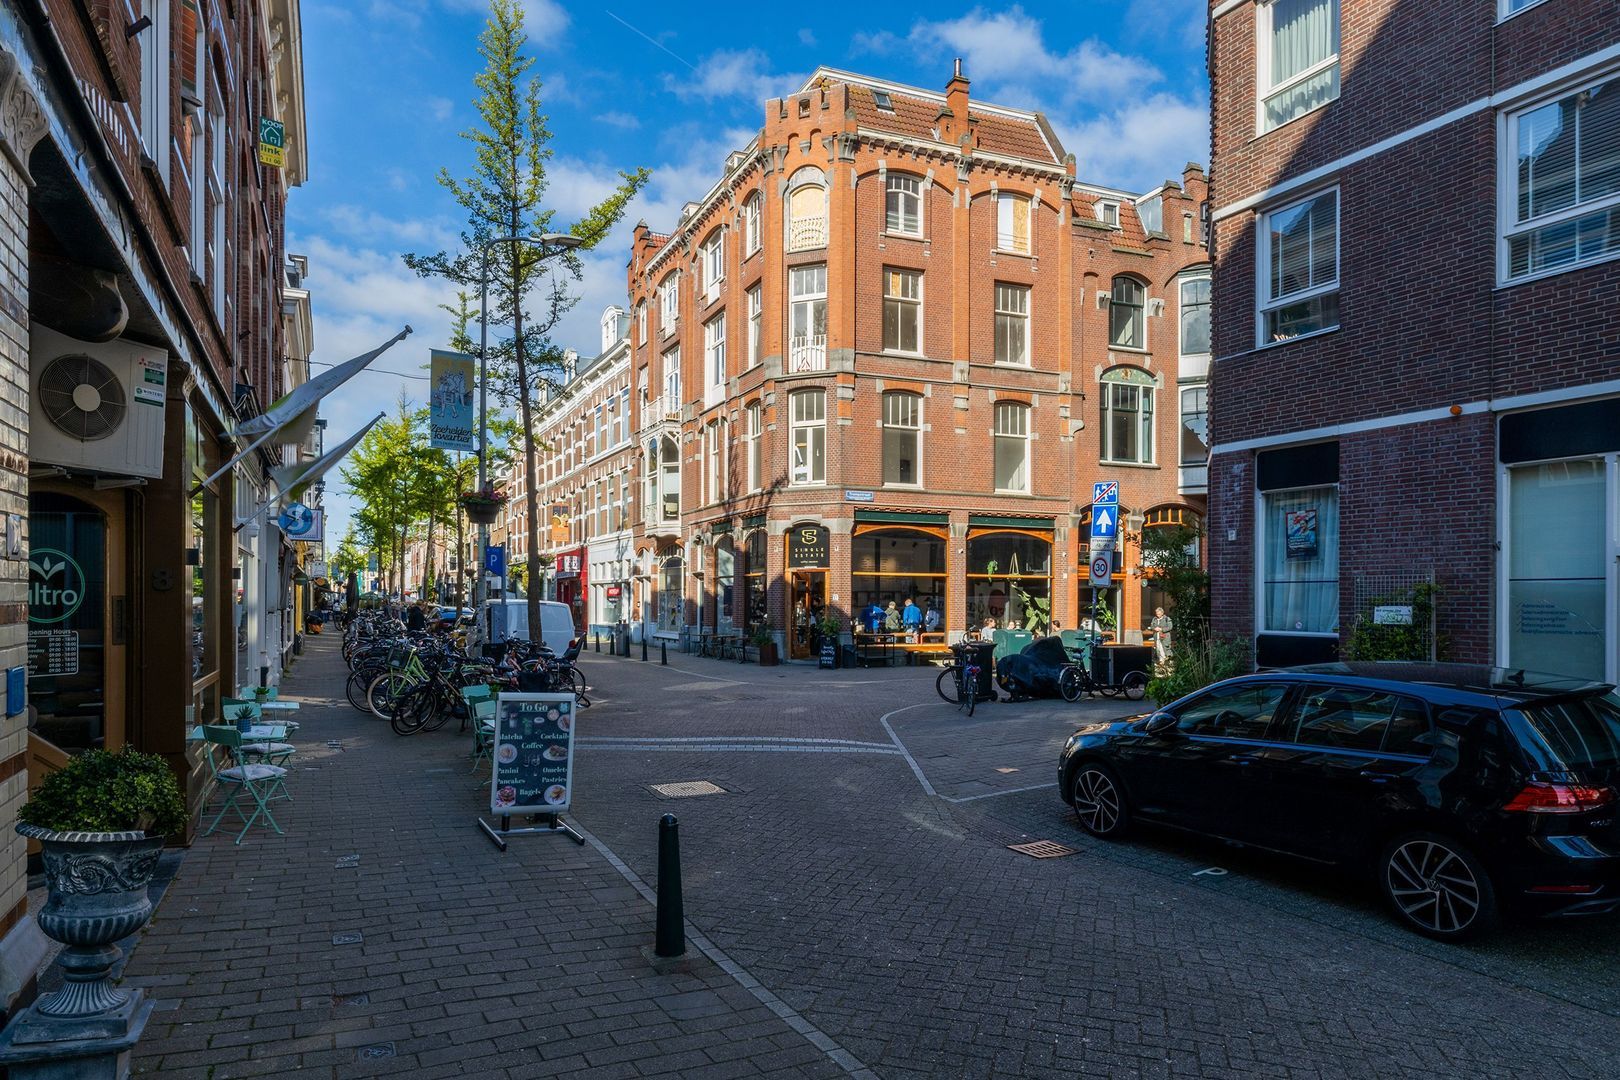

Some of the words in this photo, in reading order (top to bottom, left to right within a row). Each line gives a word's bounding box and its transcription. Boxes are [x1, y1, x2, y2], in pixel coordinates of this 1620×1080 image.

[430, 424, 473, 436] Zeehelden
[434, 432, 470, 442] kwartier
[490, 554, 497, 566] P
[1095, 563, 1105, 572] 30
[520, 702, 533, 711] To
[534, 702, 548, 711] Go
[520, 788, 541, 796] Bagels
[1192, 866, 1228, 876] P
